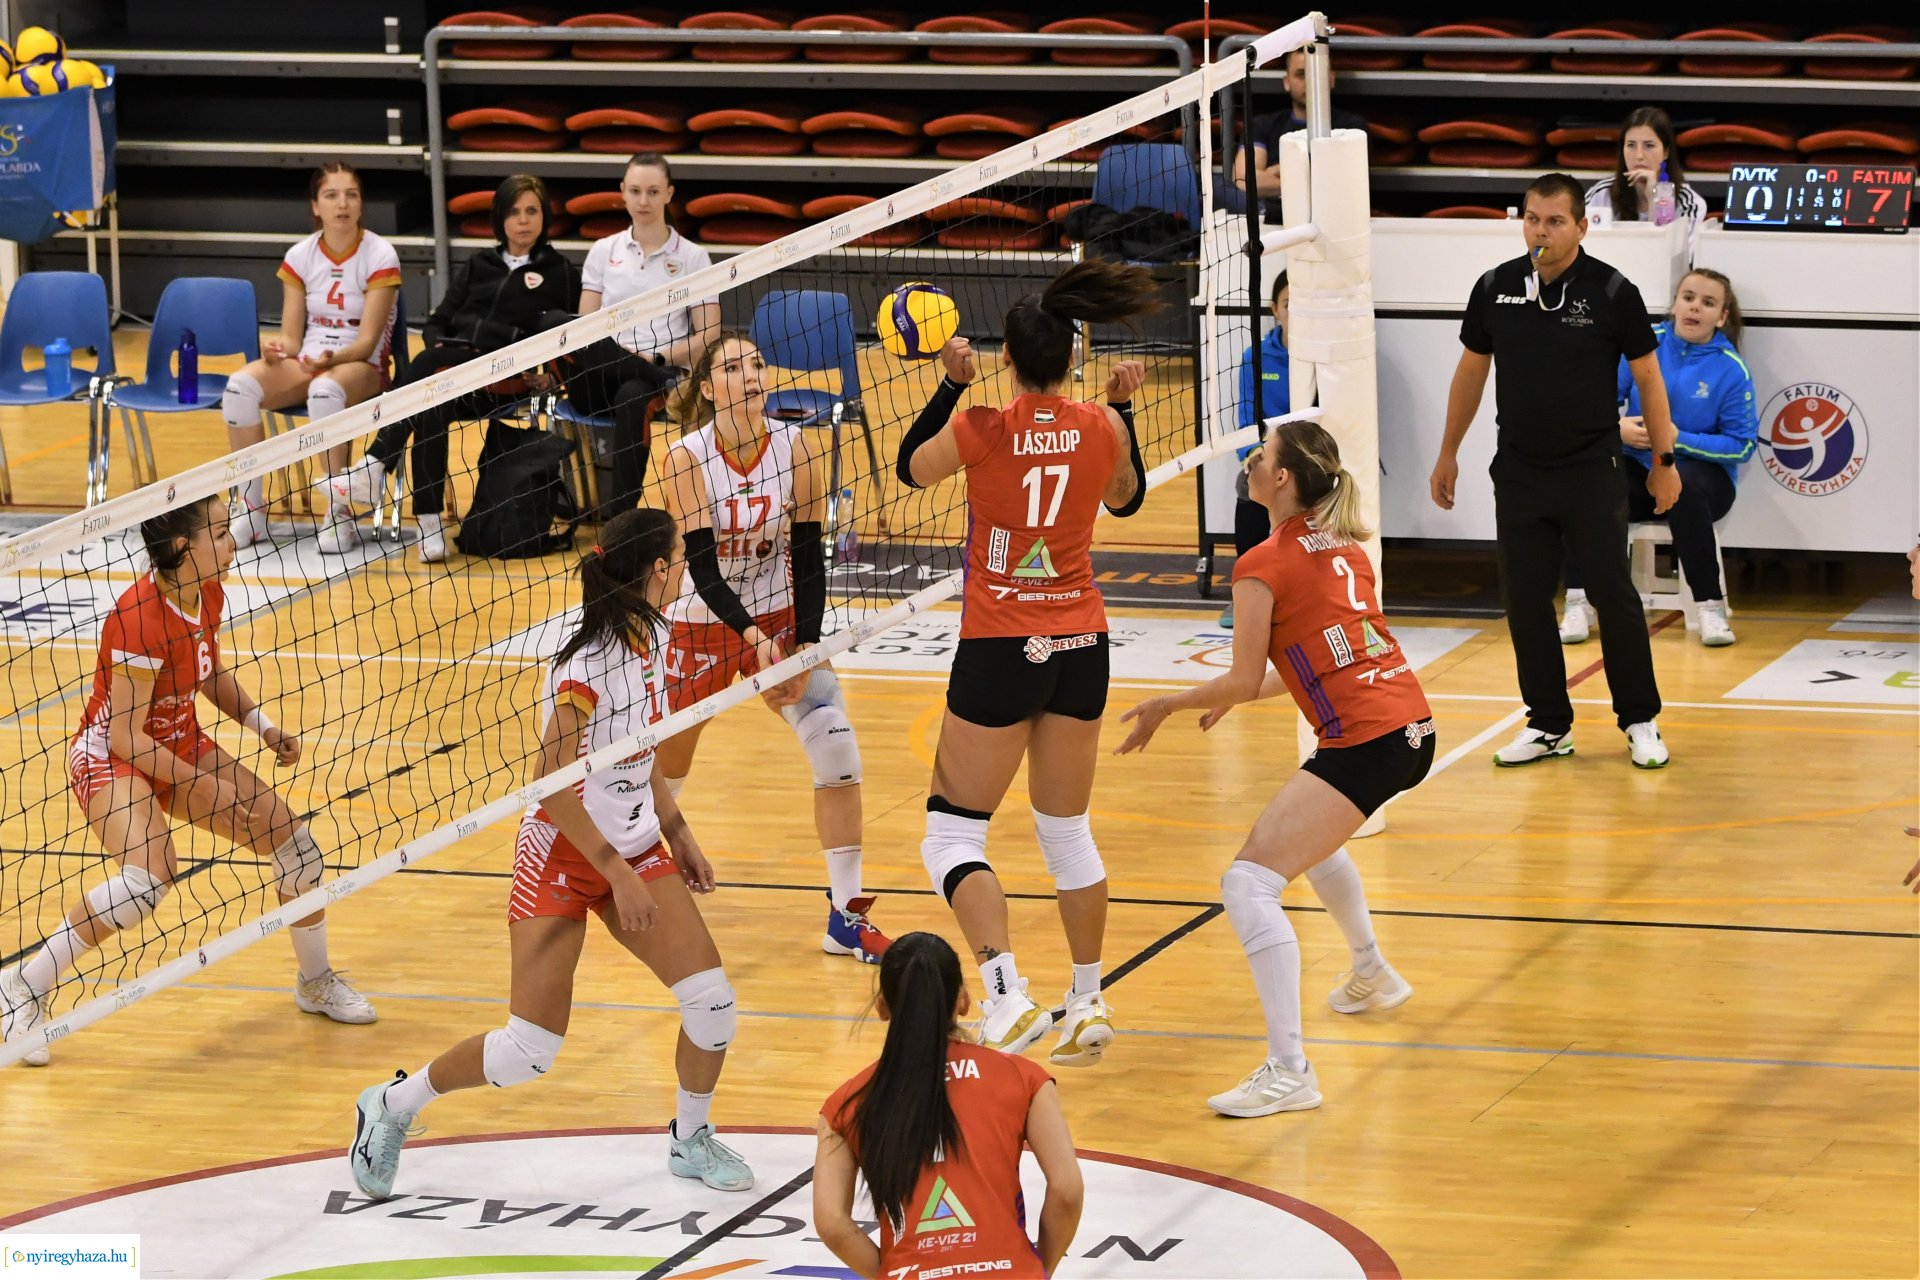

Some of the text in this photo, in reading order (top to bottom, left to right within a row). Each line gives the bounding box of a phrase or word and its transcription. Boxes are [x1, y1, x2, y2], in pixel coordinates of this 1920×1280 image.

[1732, 167, 1778, 182] DVTK
[1852, 170, 1912, 184] FATUM
[1865, 189, 1893, 224] 7
[326, 280, 345, 311] 4
[1495, 294, 1527, 305] Zeus
[1784, 385, 1841, 403] FATUM
[1013, 428, 1081, 456] LÁSZLOP
[1022, 464, 1070, 528] 17
[720, 494, 772, 536] 17
[993, 529, 1006, 571] STRABAG
[1017, 589, 1081, 601] BESTRONG
[1332, 555, 1368, 611] 2
[1051, 634, 1097, 652] REVESZ
[1330, 628, 1349, 665] STRABAG
[197, 640, 213, 681] 6
[646, 681, 664, 725] 1
[994, 965, 1007, 995] MIKASA
[917, 1233, 960, 1250] KE-VIZ
[962, 1231, 977, 1243] 21
[918, 1259, 1012, 1280] BESTRONG
